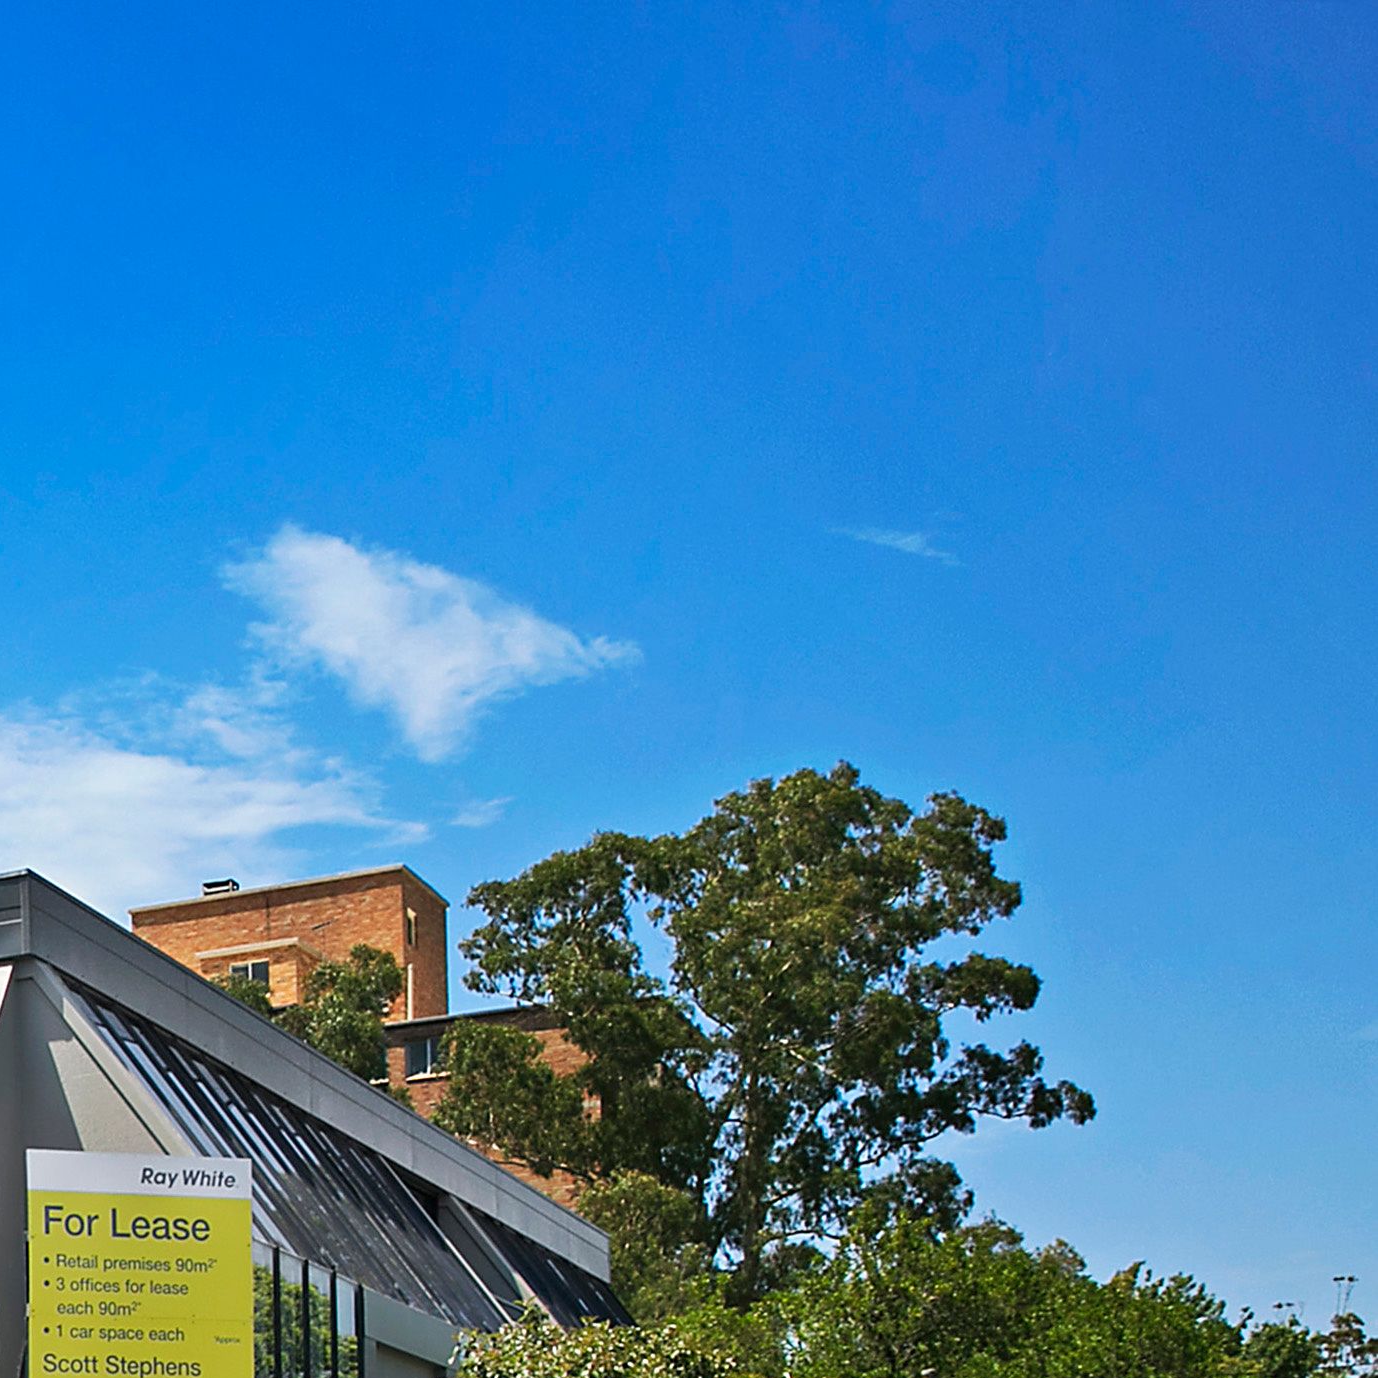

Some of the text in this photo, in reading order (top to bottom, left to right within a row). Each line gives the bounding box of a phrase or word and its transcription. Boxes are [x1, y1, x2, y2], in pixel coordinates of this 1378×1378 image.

[140, 1168, 236, 1188] Ray White
[44, 1205, 210, 1242] For Lease
[56, 1254, 98, 1269] Retail
[103, 1256, 171, 1273] premises
[56, 1277, 189, 1295] 3 offices for lease
[57, 1303, 93, 1315] each
[56, 1325, 185, 1342] 1 car space each
[43, 1353, 202, 1378] Scott Stephens
